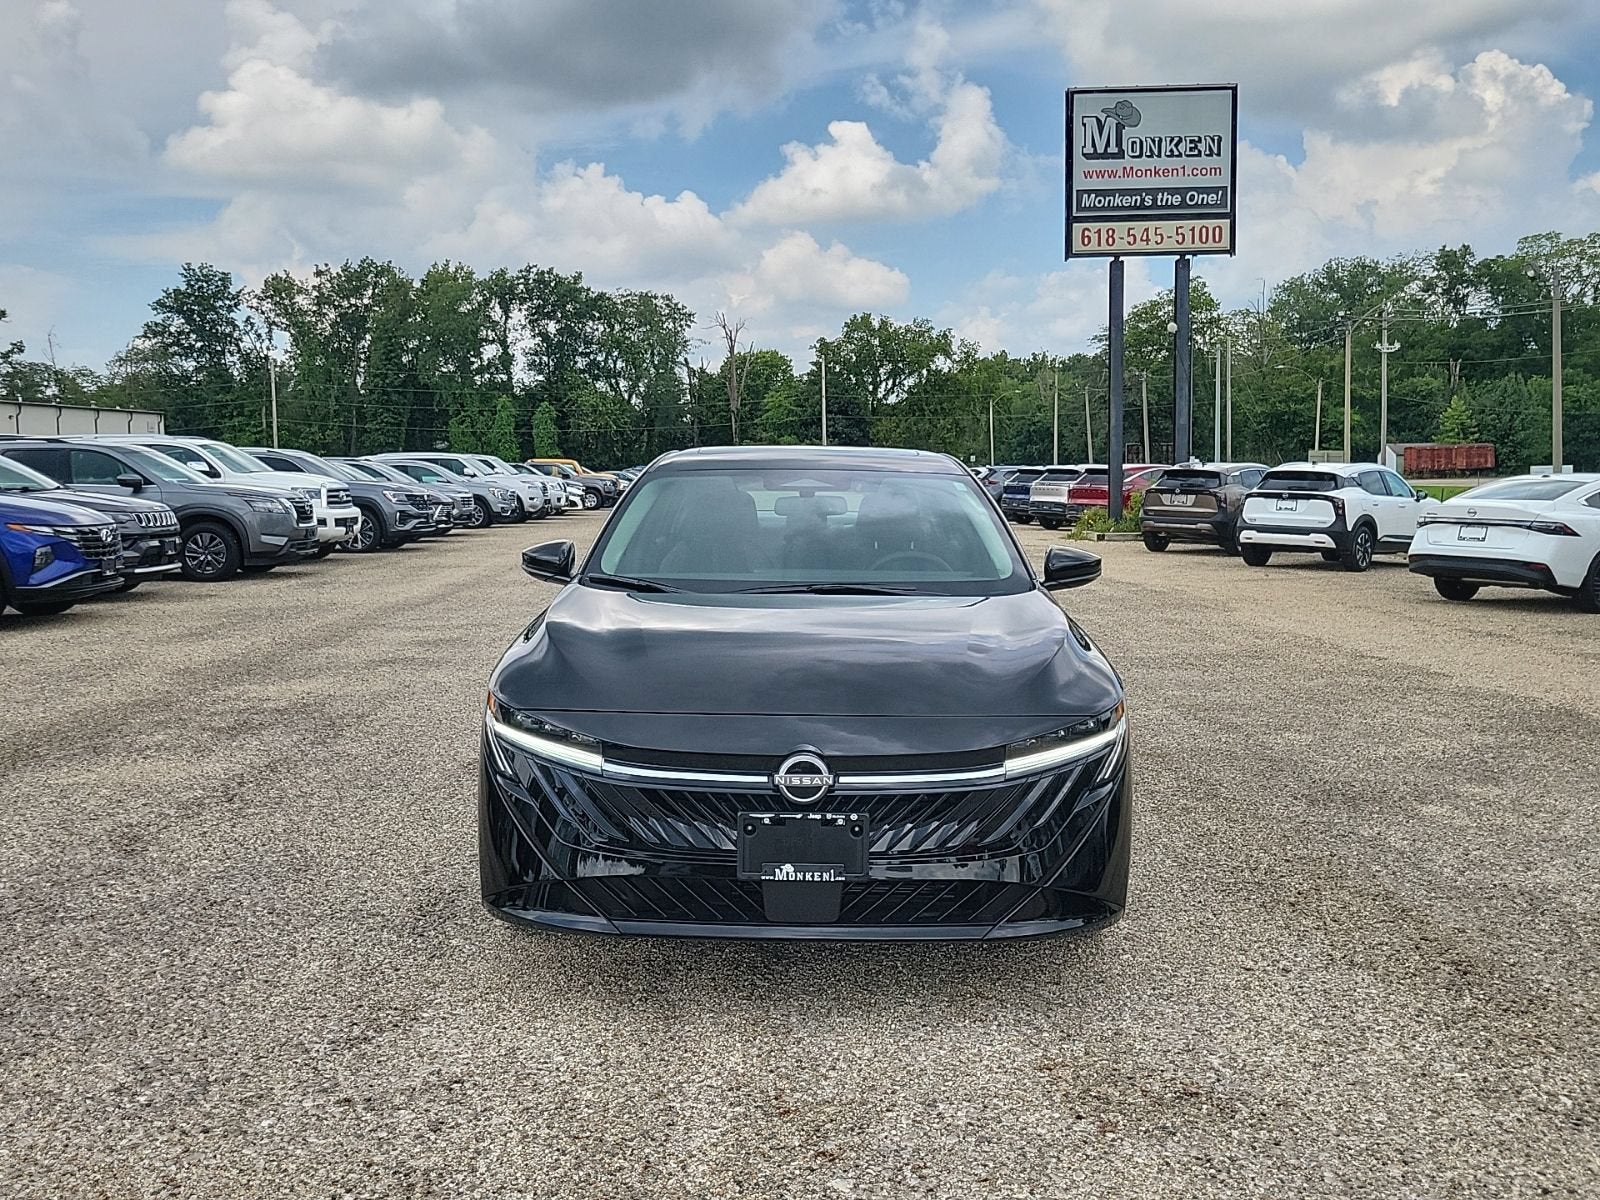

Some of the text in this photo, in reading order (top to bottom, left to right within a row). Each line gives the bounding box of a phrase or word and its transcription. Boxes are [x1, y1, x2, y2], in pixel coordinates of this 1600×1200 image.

[1082, 116, 1222, 160] MONKEN
[1083, 165, 1222, 179] www.Monken1.com
[1081, 190, 1222, 208] Monken's the One!
[1080, 225, 1223, 247] 618-545-5100
[775, 776, 833, 785] NISSAN
